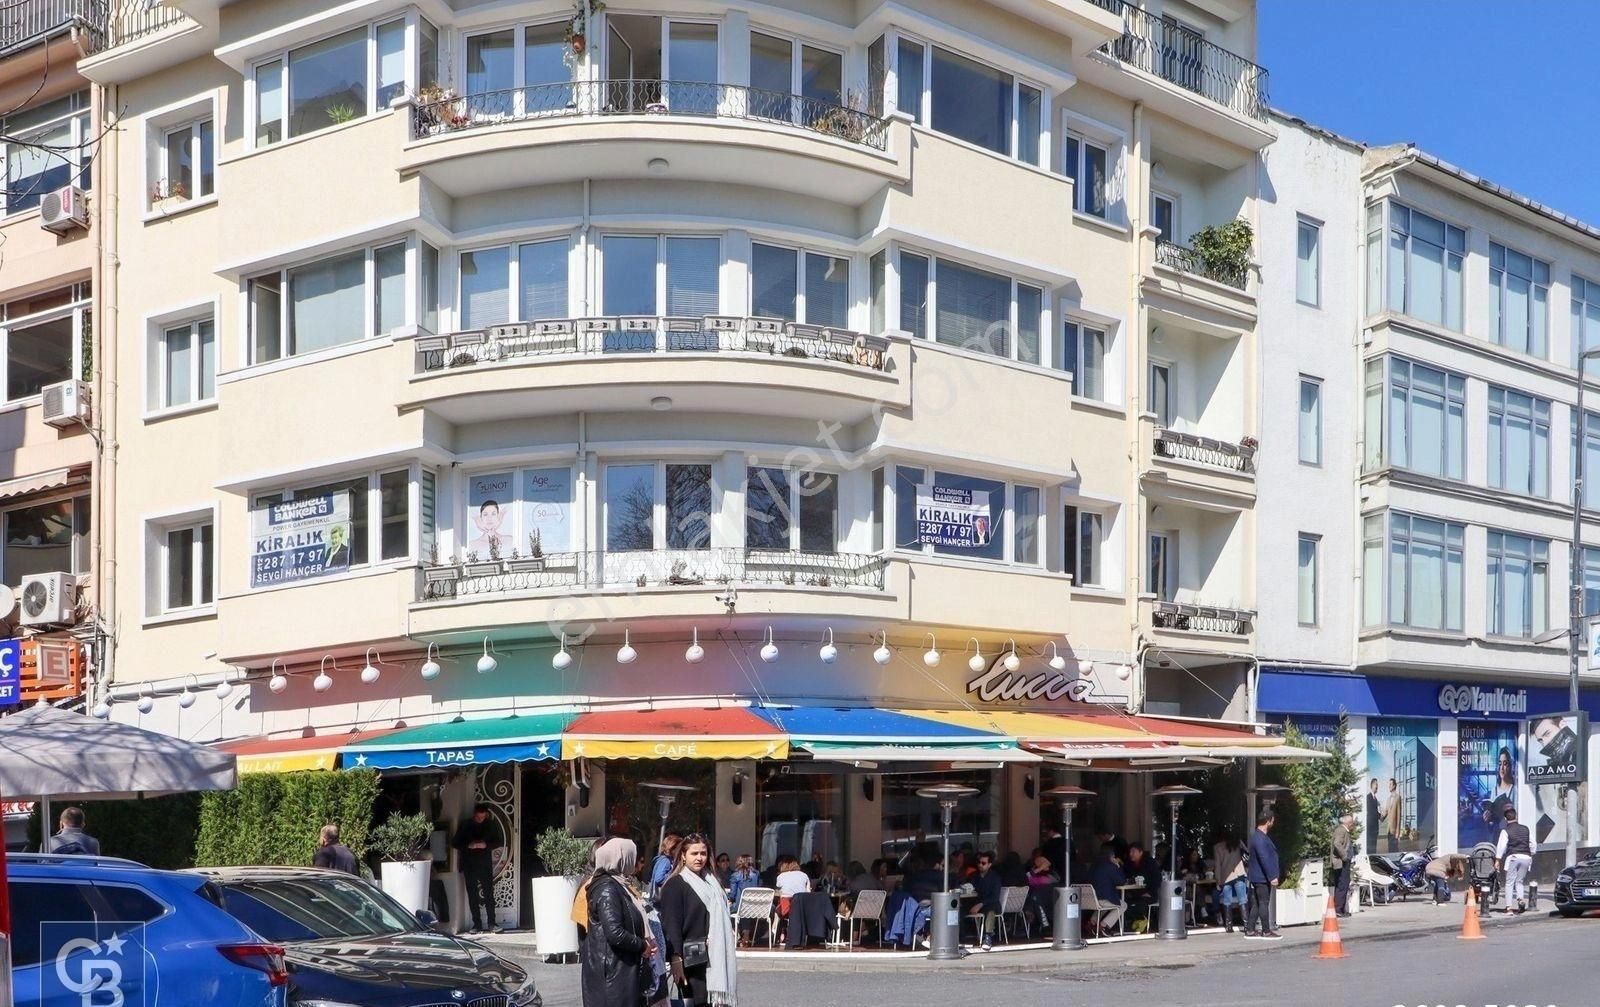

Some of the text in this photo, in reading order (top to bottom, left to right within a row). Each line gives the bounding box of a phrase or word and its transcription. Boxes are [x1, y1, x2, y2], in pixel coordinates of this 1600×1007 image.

[531, 476, 549, 487] Age
[920, 506, 971, 524] KİRALIK
[926, 523, 943, 535] 287
[945, 525, 957, 536] 17
[960, 526, 971, 537] 97
[256, 530, 323, 553] KİRALIK
[921, 535, 970, 547] SEVGİ HANÇER
[264, 555, 285, 569] 287
[290, 552, 304, 564] 17
[308, 548, 323, 562] 97
[257, 563, 322, 582] SEVGİ HANÇER
[1461, 726, 1485, 738] KÜLTÜR
[654, 742, 697, 755] CAFÉ
[1461, 741, 1488, 751] SANATTA
[427, 751, 475, 762] TAPAS
[1529, 764, 1576, 775] ADAMO
